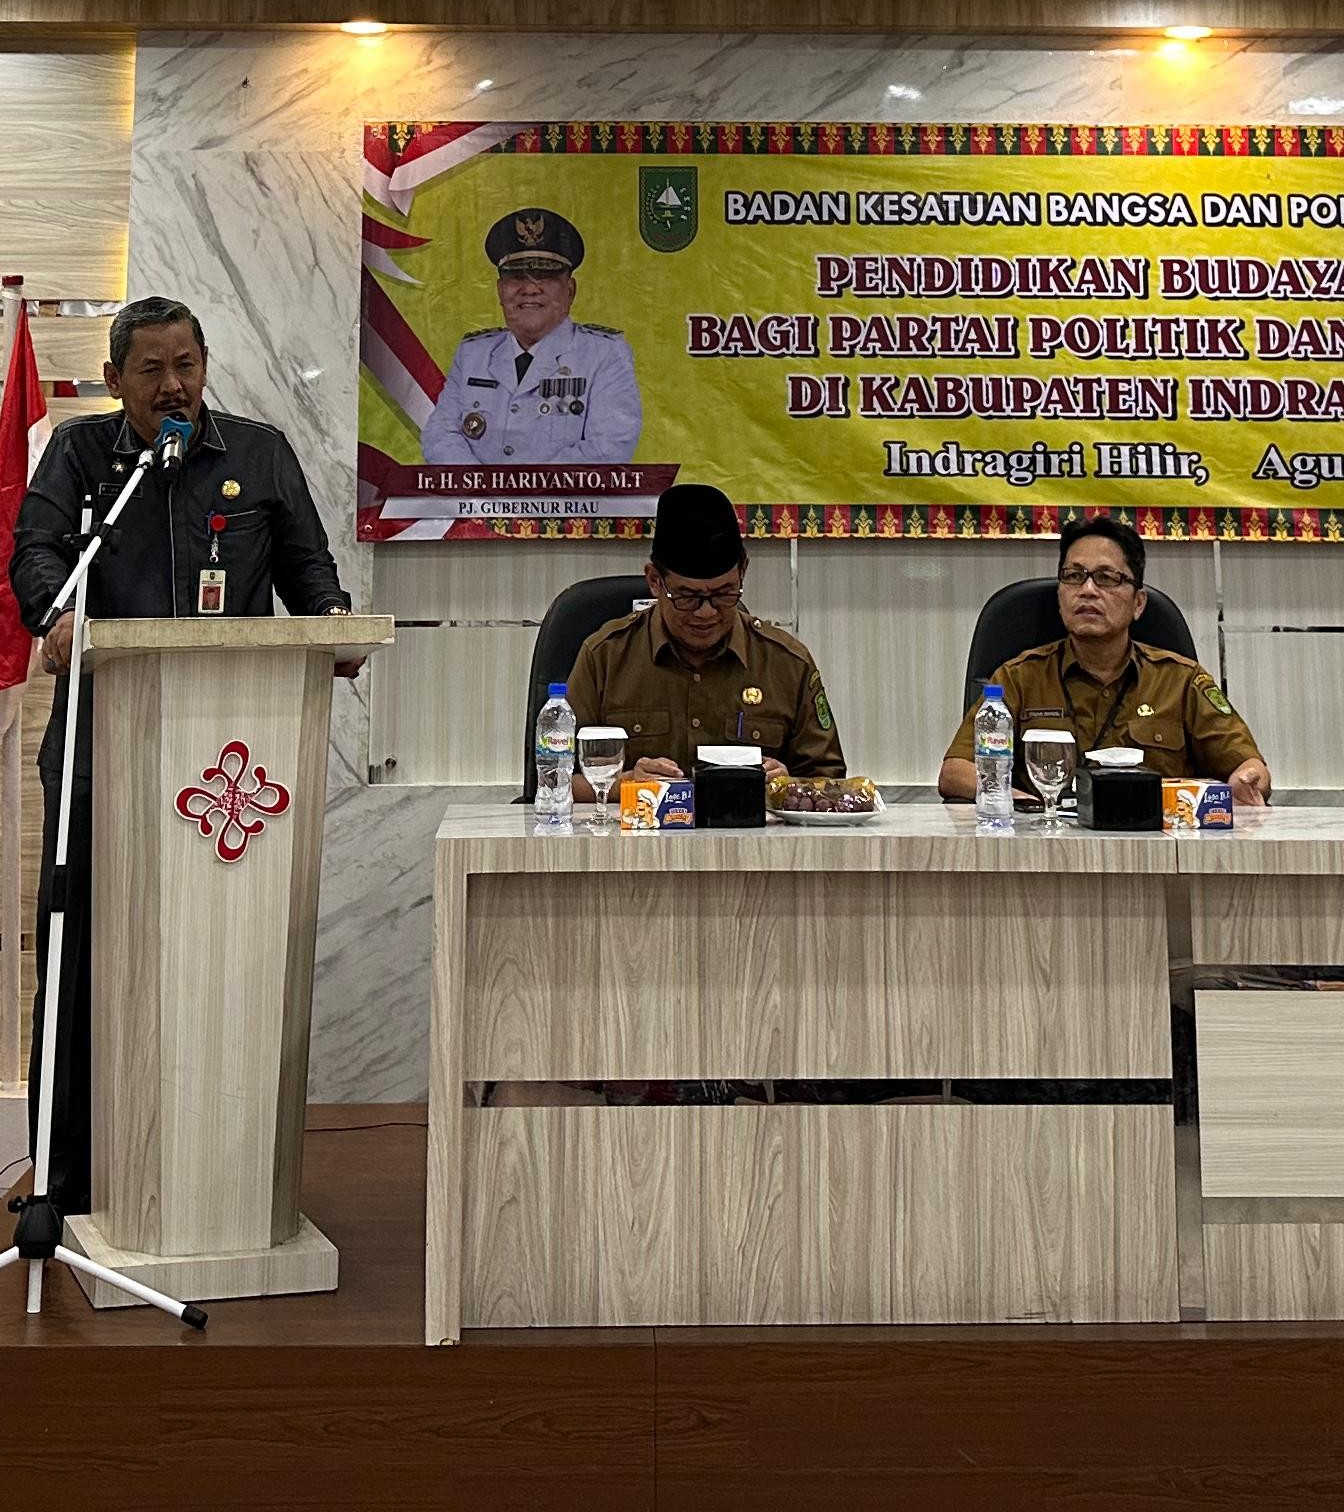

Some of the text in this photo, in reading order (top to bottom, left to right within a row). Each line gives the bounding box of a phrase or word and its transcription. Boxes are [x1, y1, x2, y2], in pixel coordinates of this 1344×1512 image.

[727, 194, 847, 223] BADAN
[859, 194, 1036, 223] KESATUAN
[1049, 195, 1192, 224] BANGSA
[1204, 197, 1278, 225] DAN
[816, 256, 1147, 297] PENDIDIKAN
[686, 315, 817, 355] BAGI
[829, 316, 1016, 356] PARTAI
[1029, 317, 1245, 357] POLITIK
[786, 375, 848, 416] DI
[860, 375, 1175, 418] KABUPATEN
[418, 473, 434, 488] Ir.
[440, 473, 457, 489] H.
[492, 472, 605, 490] HARIYANTO,
[610, 472, 644, 488] M.T
[885, 442, 1084, 484] Indragiri
[1095, 443, 1206, 485] Hilir,
[458, 501, 599, 514] PJ. GUBERNUR RIAU
